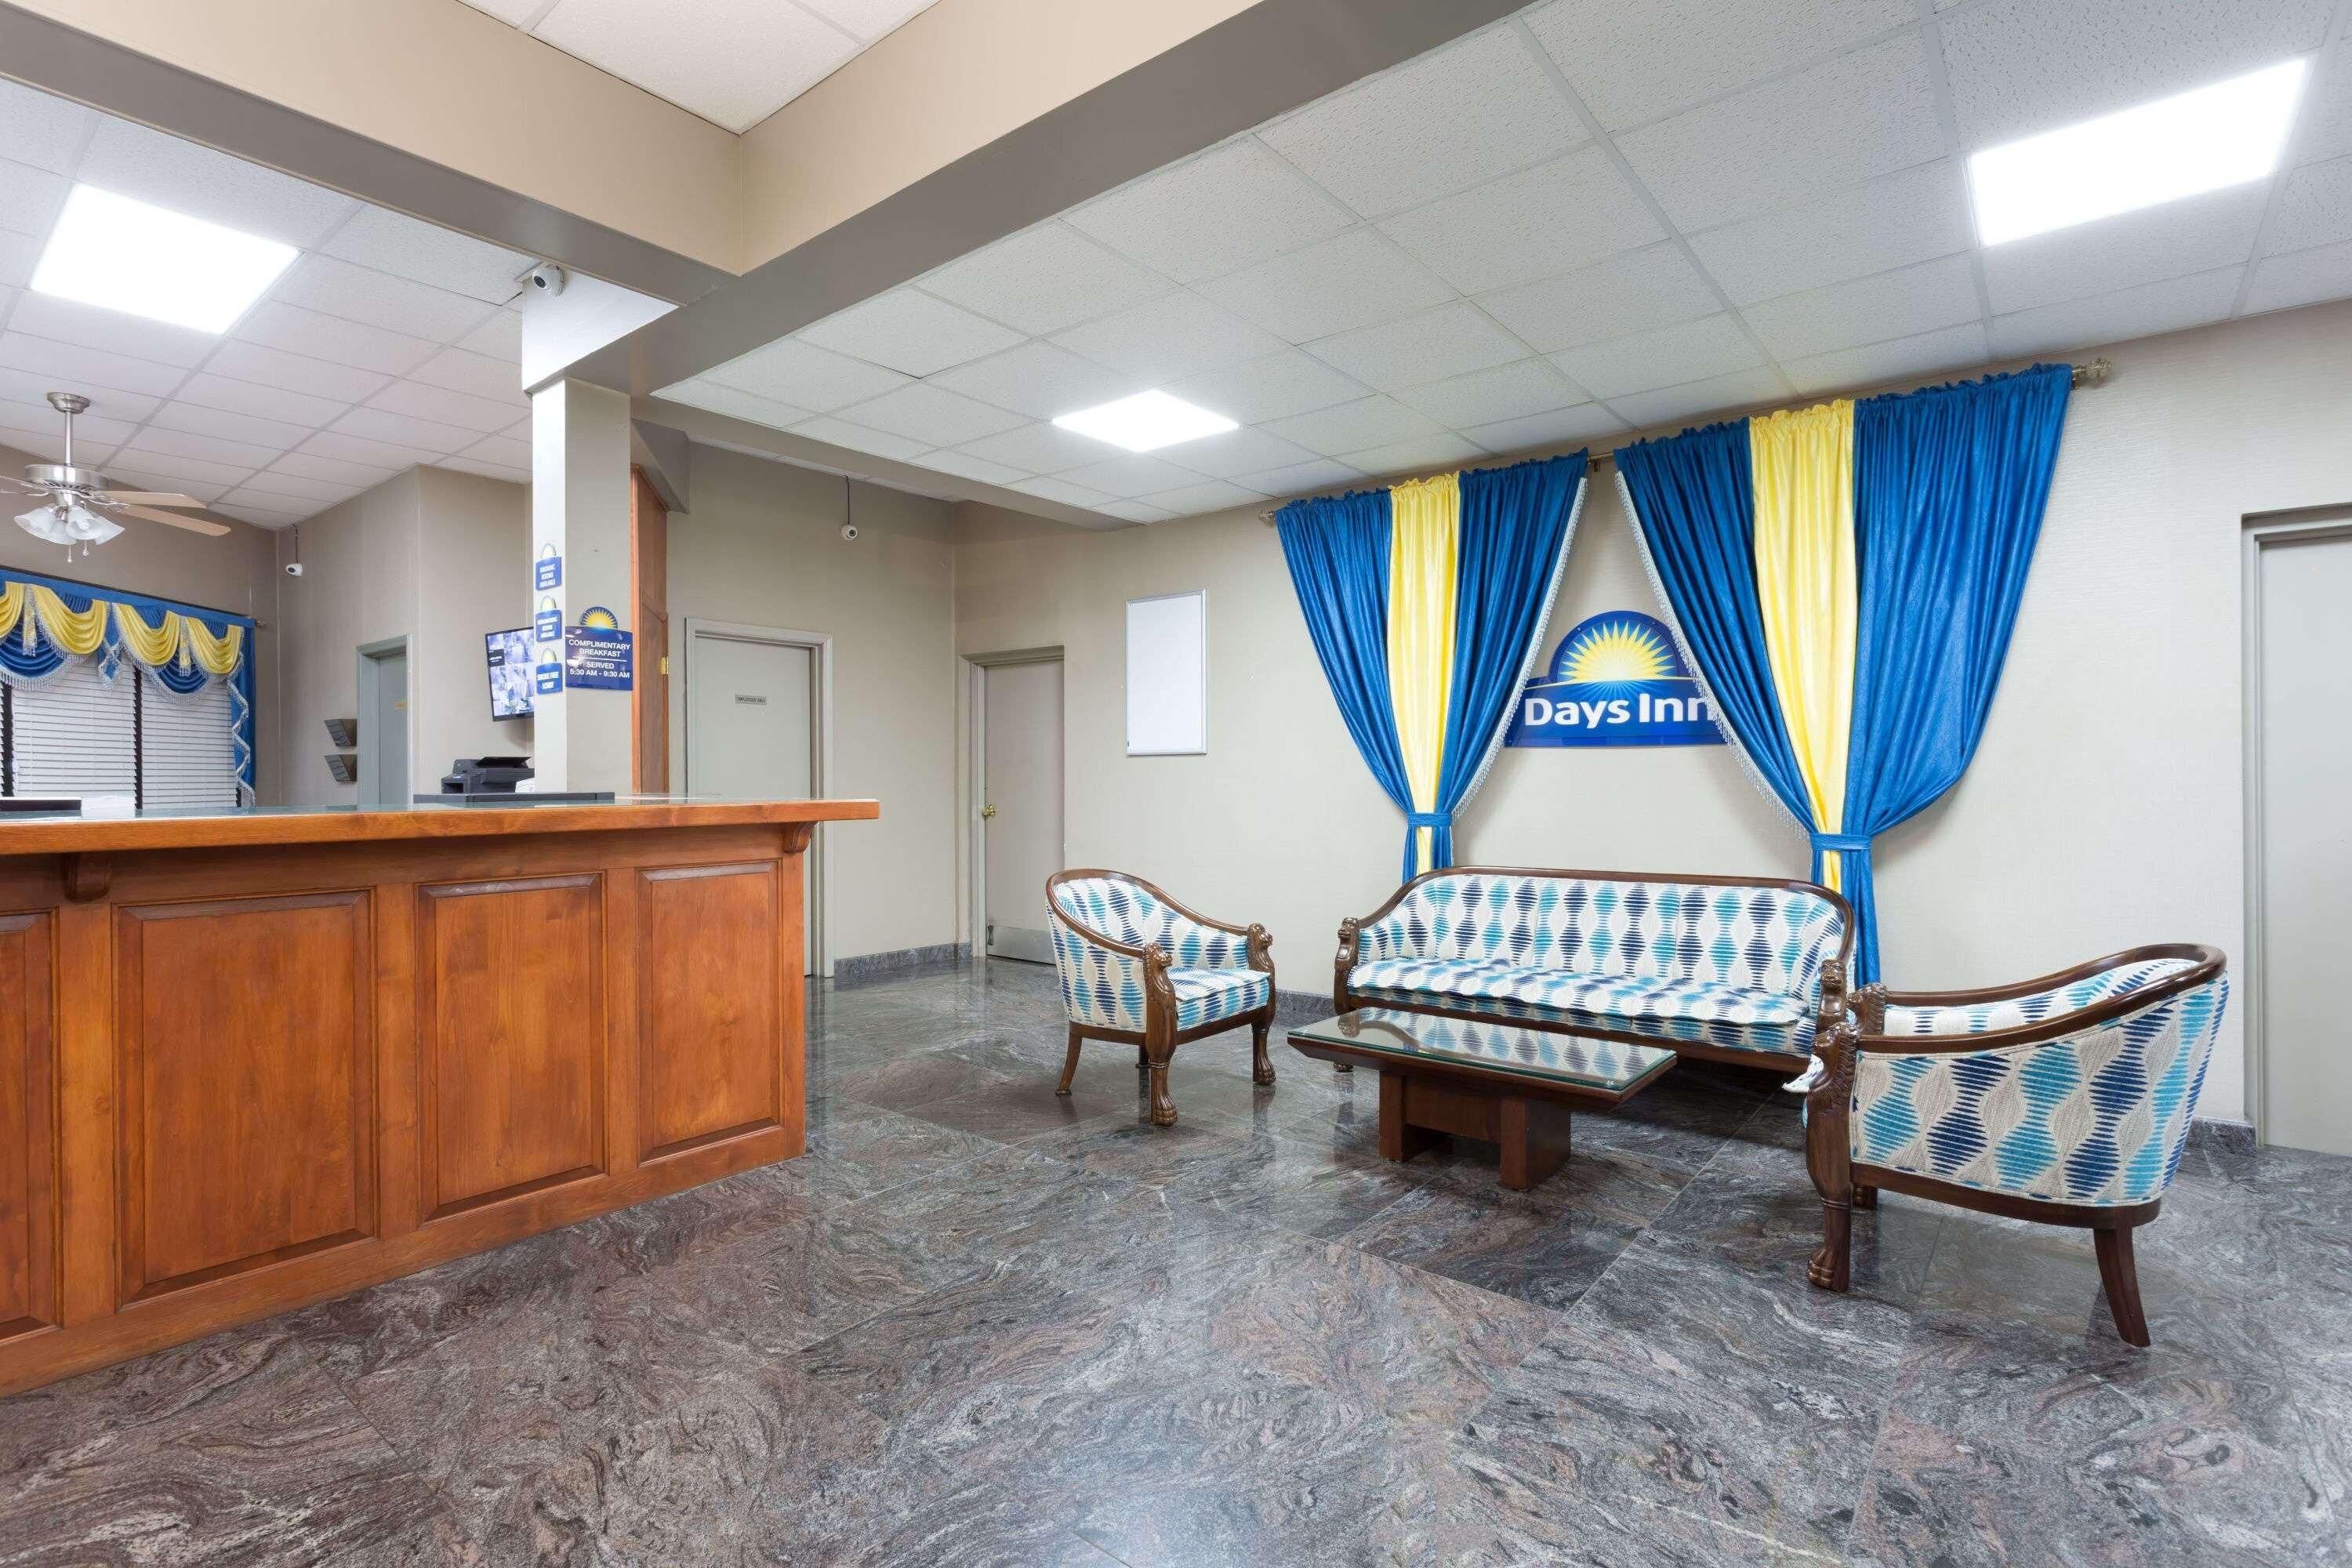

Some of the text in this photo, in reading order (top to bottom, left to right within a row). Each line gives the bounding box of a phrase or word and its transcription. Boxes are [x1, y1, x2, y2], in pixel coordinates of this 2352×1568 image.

[568, 639, 631, 650] COMPLIMENTARY
[579, 648, 621, 657] BREAKFAST
[1524, 693, 1715, 729] Days Inn
